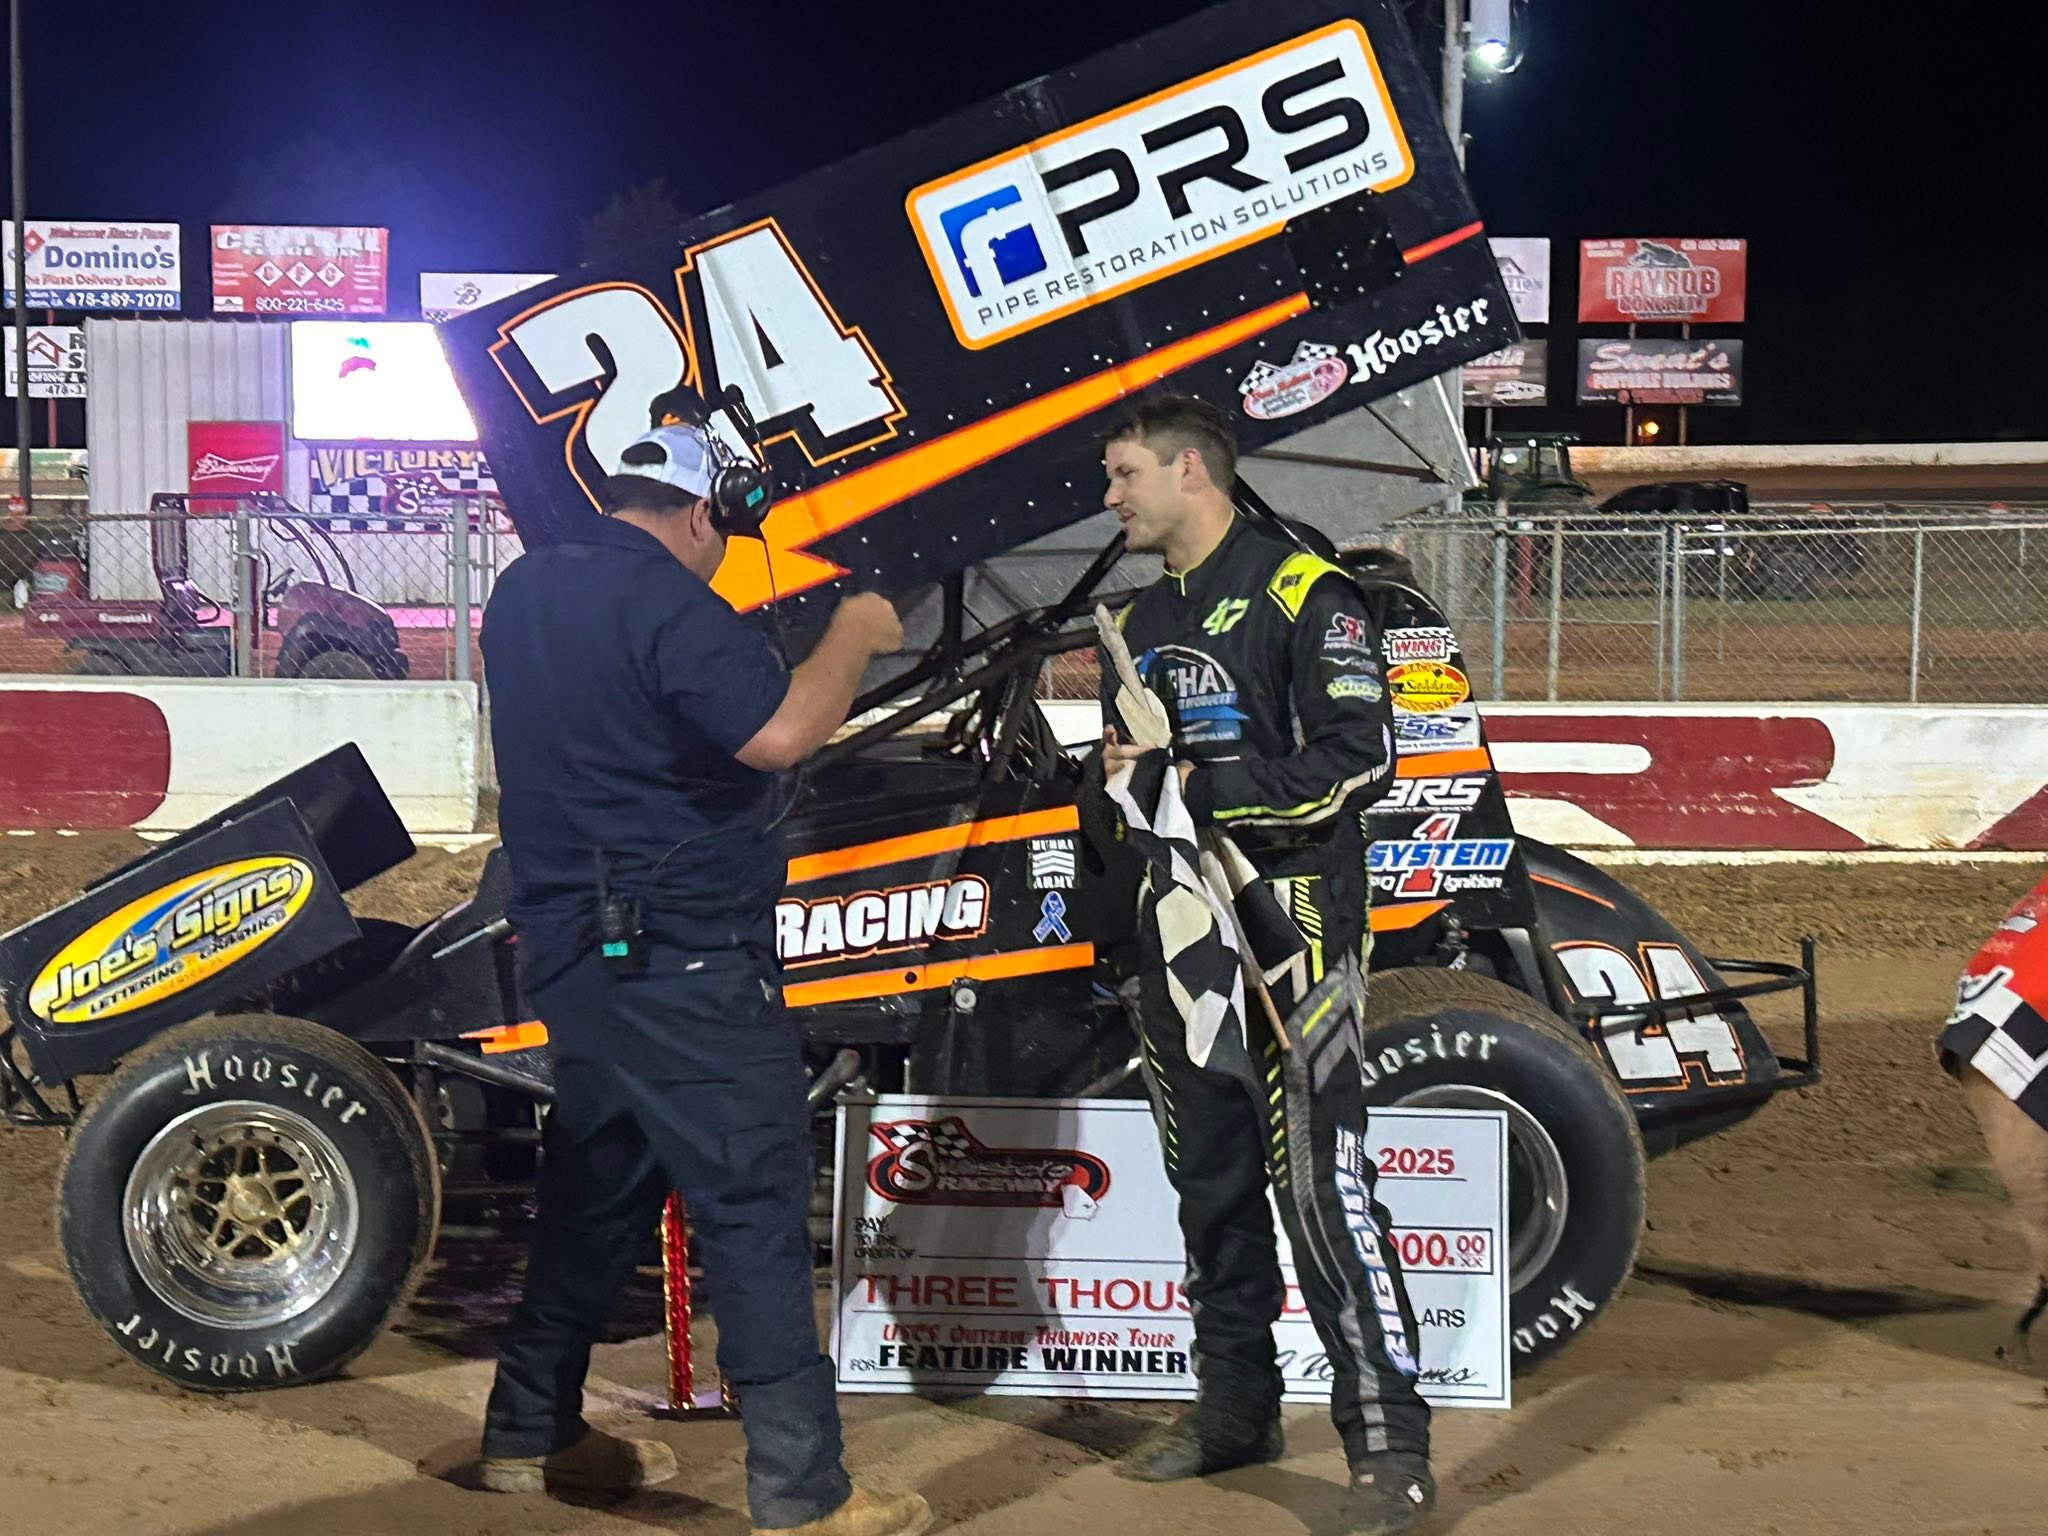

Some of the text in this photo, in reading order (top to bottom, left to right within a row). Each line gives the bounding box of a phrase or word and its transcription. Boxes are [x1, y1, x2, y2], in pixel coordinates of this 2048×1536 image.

[1040, 56, 1371, 258] PRS
[44, 244, 175, 269] Domino's
[978, 151, 1390, 326] PIPE RESTORATION SOLUTIONS
[488, 218, 907, 500] 24
[1345, 298, 1489, 384] Hoosier
[316, 449, 477, 488] VICTORY
[1202, 597, 1250, 636] 47
[1367, 840, 1513, 870] SYSTEM
[1443, 873, 1503, 893] Ignition
[50, 864, 295, 1010] Joe's Signs
[774, 874, 990, 962] RACING
[1553, 940, 1748, 1092] 24
[1361, 1023, 1498, 1088] oosier
[181, 1050, 367, 1124] Hoosier
[1377, 1148, 1456, 1175] 2025
[854, 1217, 889, 1233] PAY
[856, 1273, 1018, 1307] THREE
[1036, 1326, 1119, 1347] THUNDER
[1128, 1327, 1176, 1348] TOUR
[1417, 1309, 1467, 1329] ARS
[116, 1314, 300, 1379] Hoosier
[879, 1345, 1028, 1371] FEATURE
[1042, 1347, 1187, 1374] WINNER
